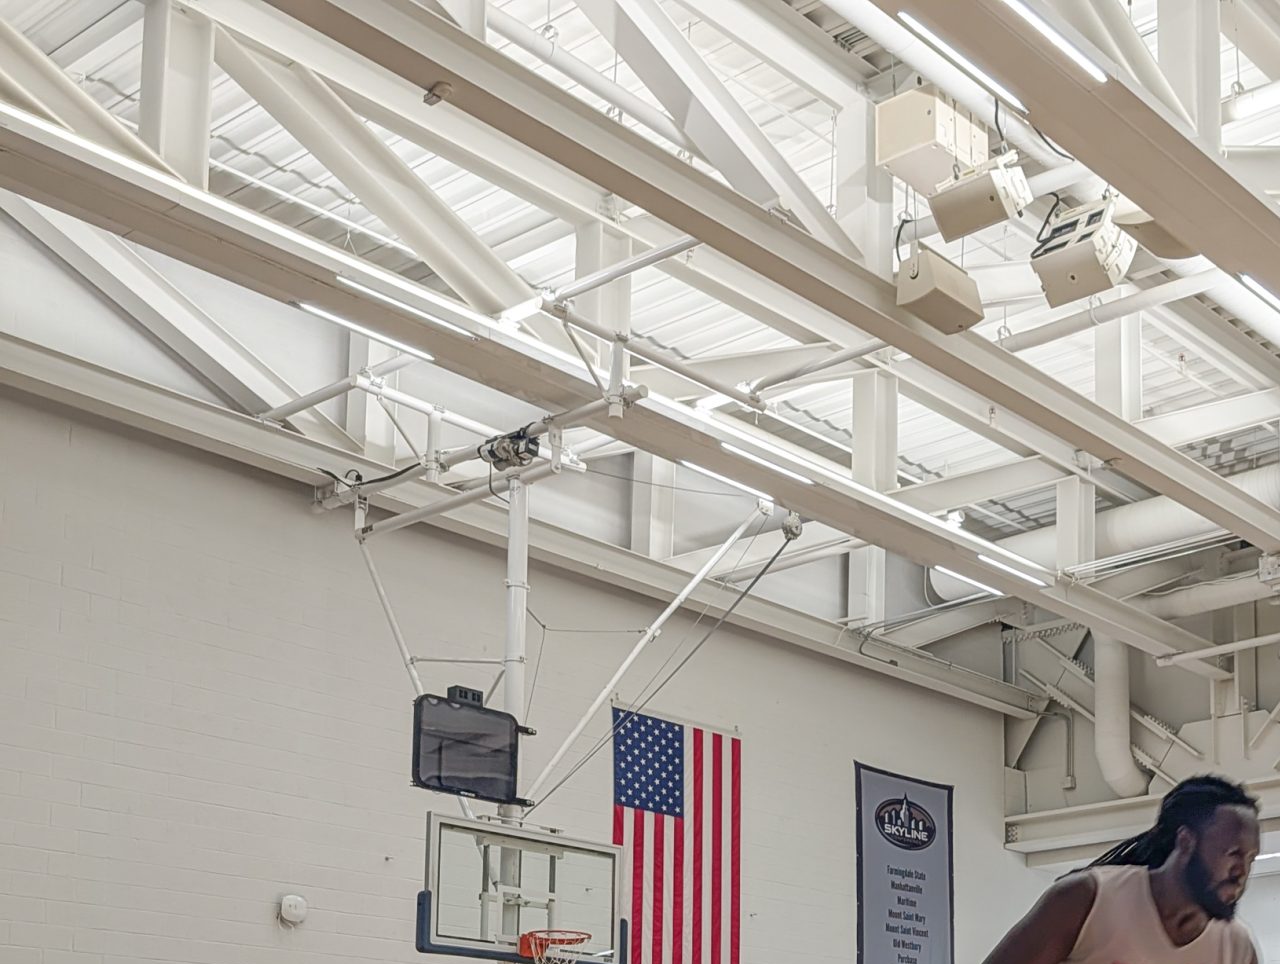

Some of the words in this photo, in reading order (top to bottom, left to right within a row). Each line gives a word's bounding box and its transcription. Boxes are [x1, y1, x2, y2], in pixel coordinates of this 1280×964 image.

[884, 823, 928, 841] SKYLINE
[897, 896, 917, 907] Maritime
[888, 908, 902, 920] Mount
[903, 910, 914, 921] Saint
[915, 913, 926, 925] Mary
[912, 926, 929, 938] Vincent
[901, 939, 922, 953] Westbury
[897, 953, 918, 964] Purchase
